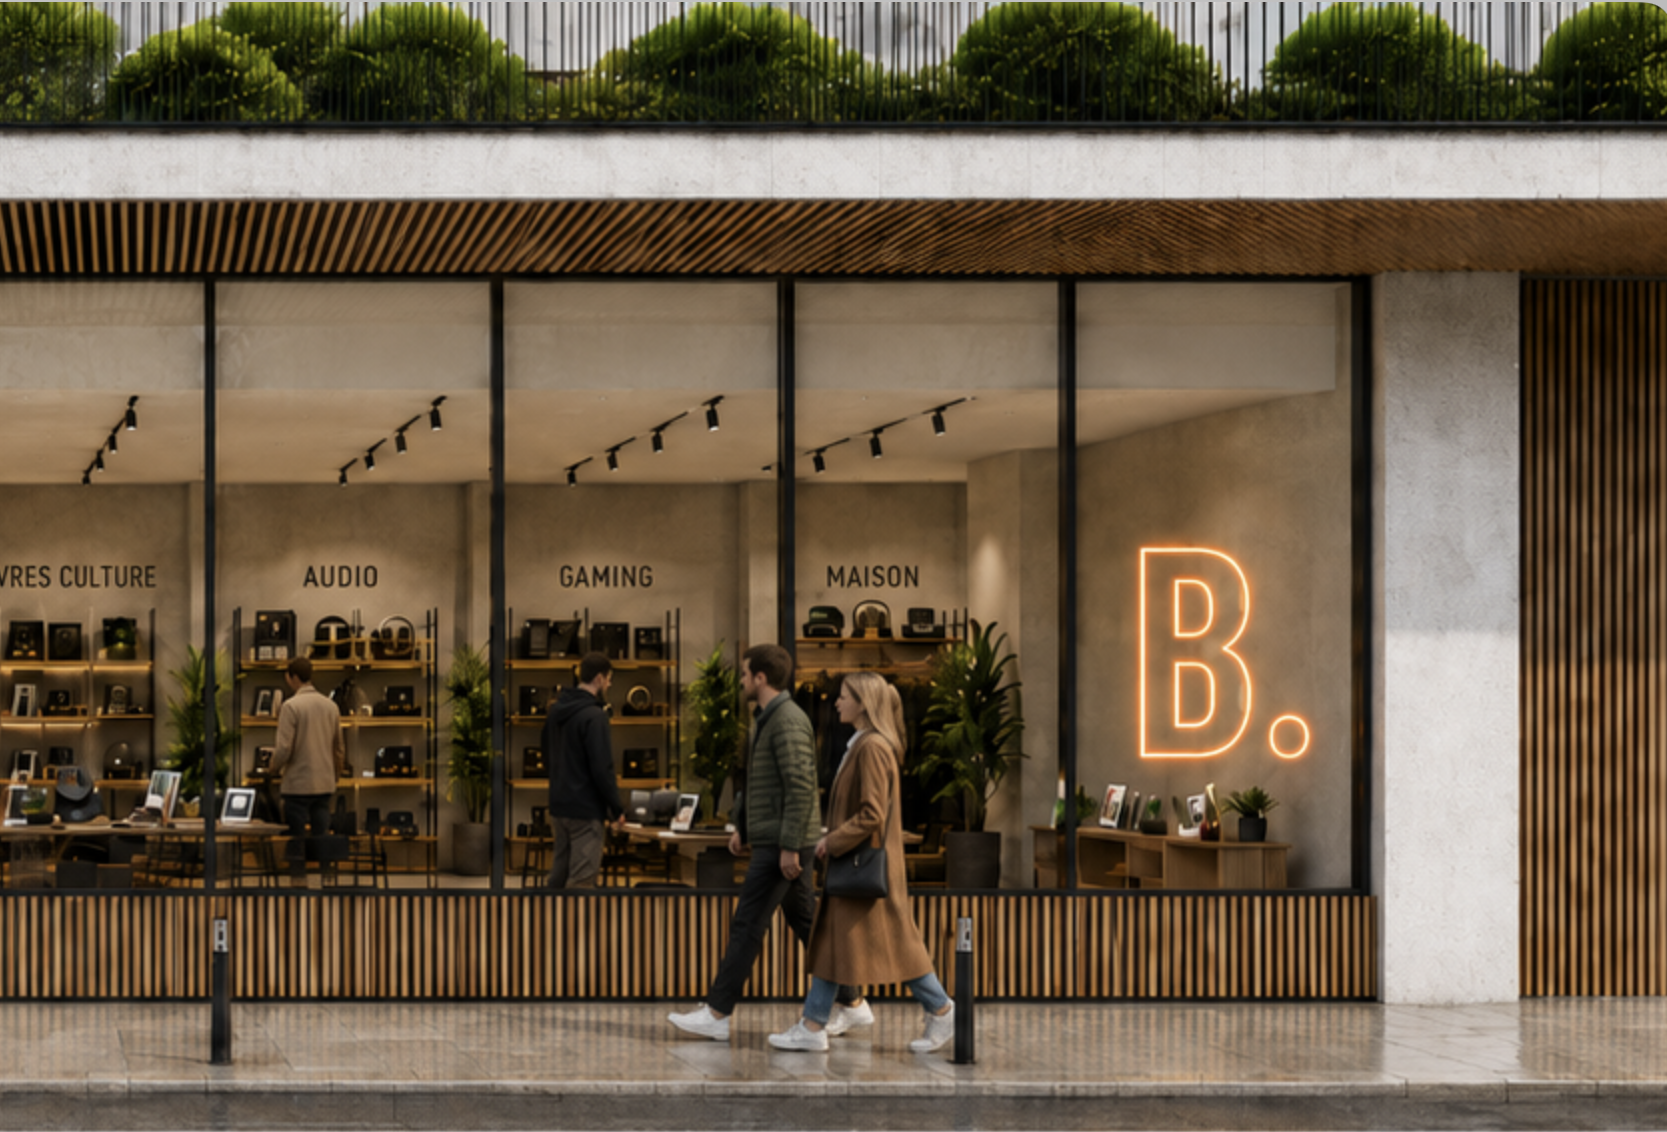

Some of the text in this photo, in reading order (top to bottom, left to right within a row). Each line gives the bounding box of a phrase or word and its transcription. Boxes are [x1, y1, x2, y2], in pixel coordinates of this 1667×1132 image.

[60, 565, 156, 588] CULTURE
[303, 565, 378, 588] AUDIO
[560, 565, 653, 588] GAMING
[827, 565, 919, 588] MAISON
